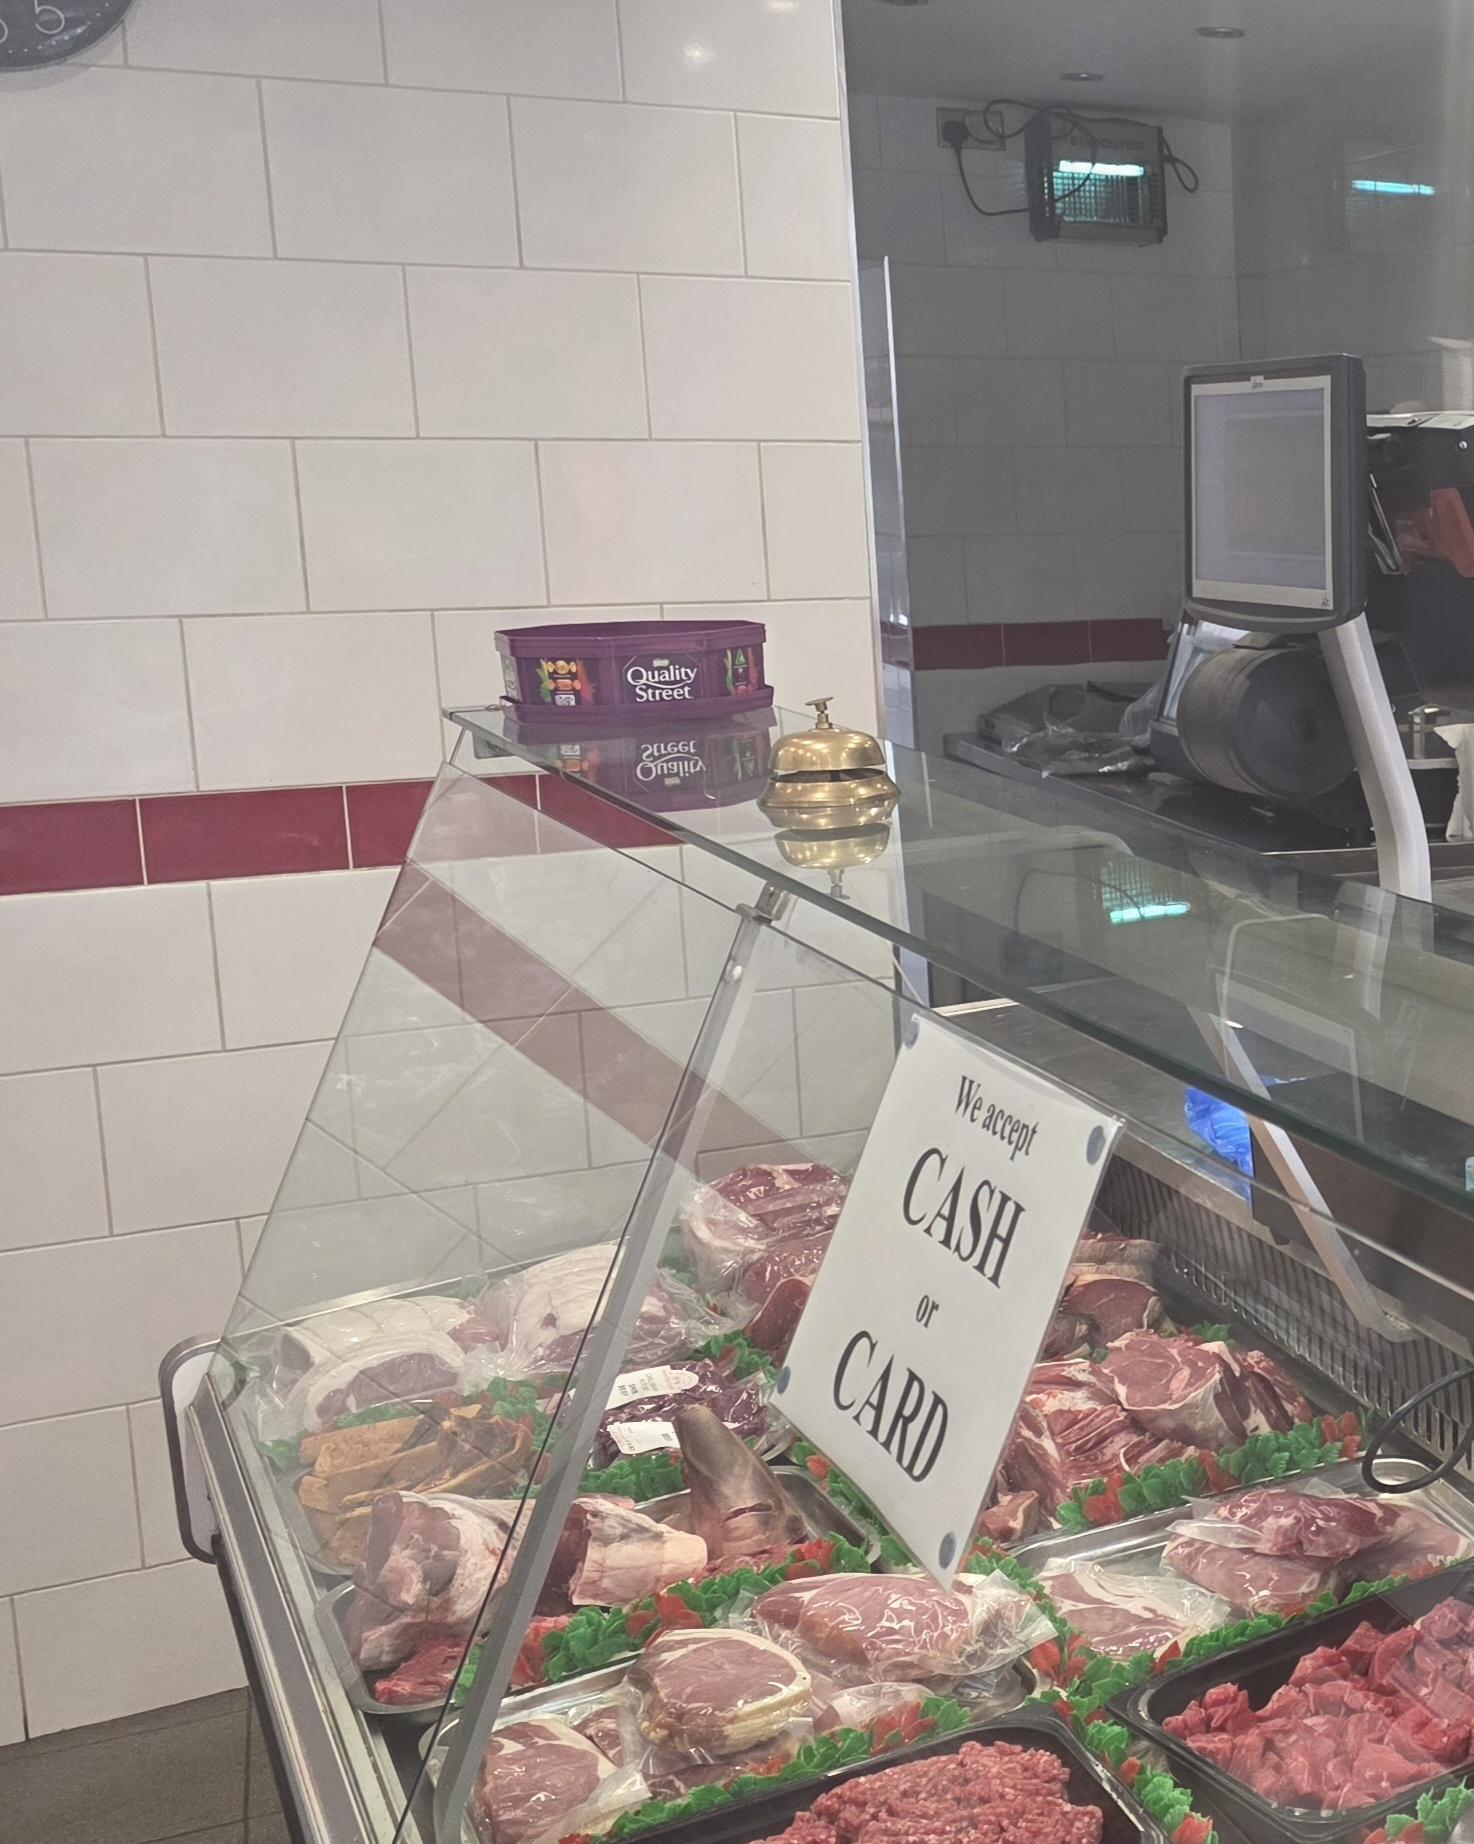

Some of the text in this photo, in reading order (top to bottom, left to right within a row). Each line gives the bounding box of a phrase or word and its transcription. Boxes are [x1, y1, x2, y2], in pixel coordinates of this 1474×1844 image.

[627, 664, 697, 689] Quality
[635, 685, 694, 703] Street
[954, 1075, 1040, 1162] We accept
[902, 1147, 1026, 1289] CASH
[915, 1294, 940, 1329] or
[832, 1329, 949, 1483] CARD
